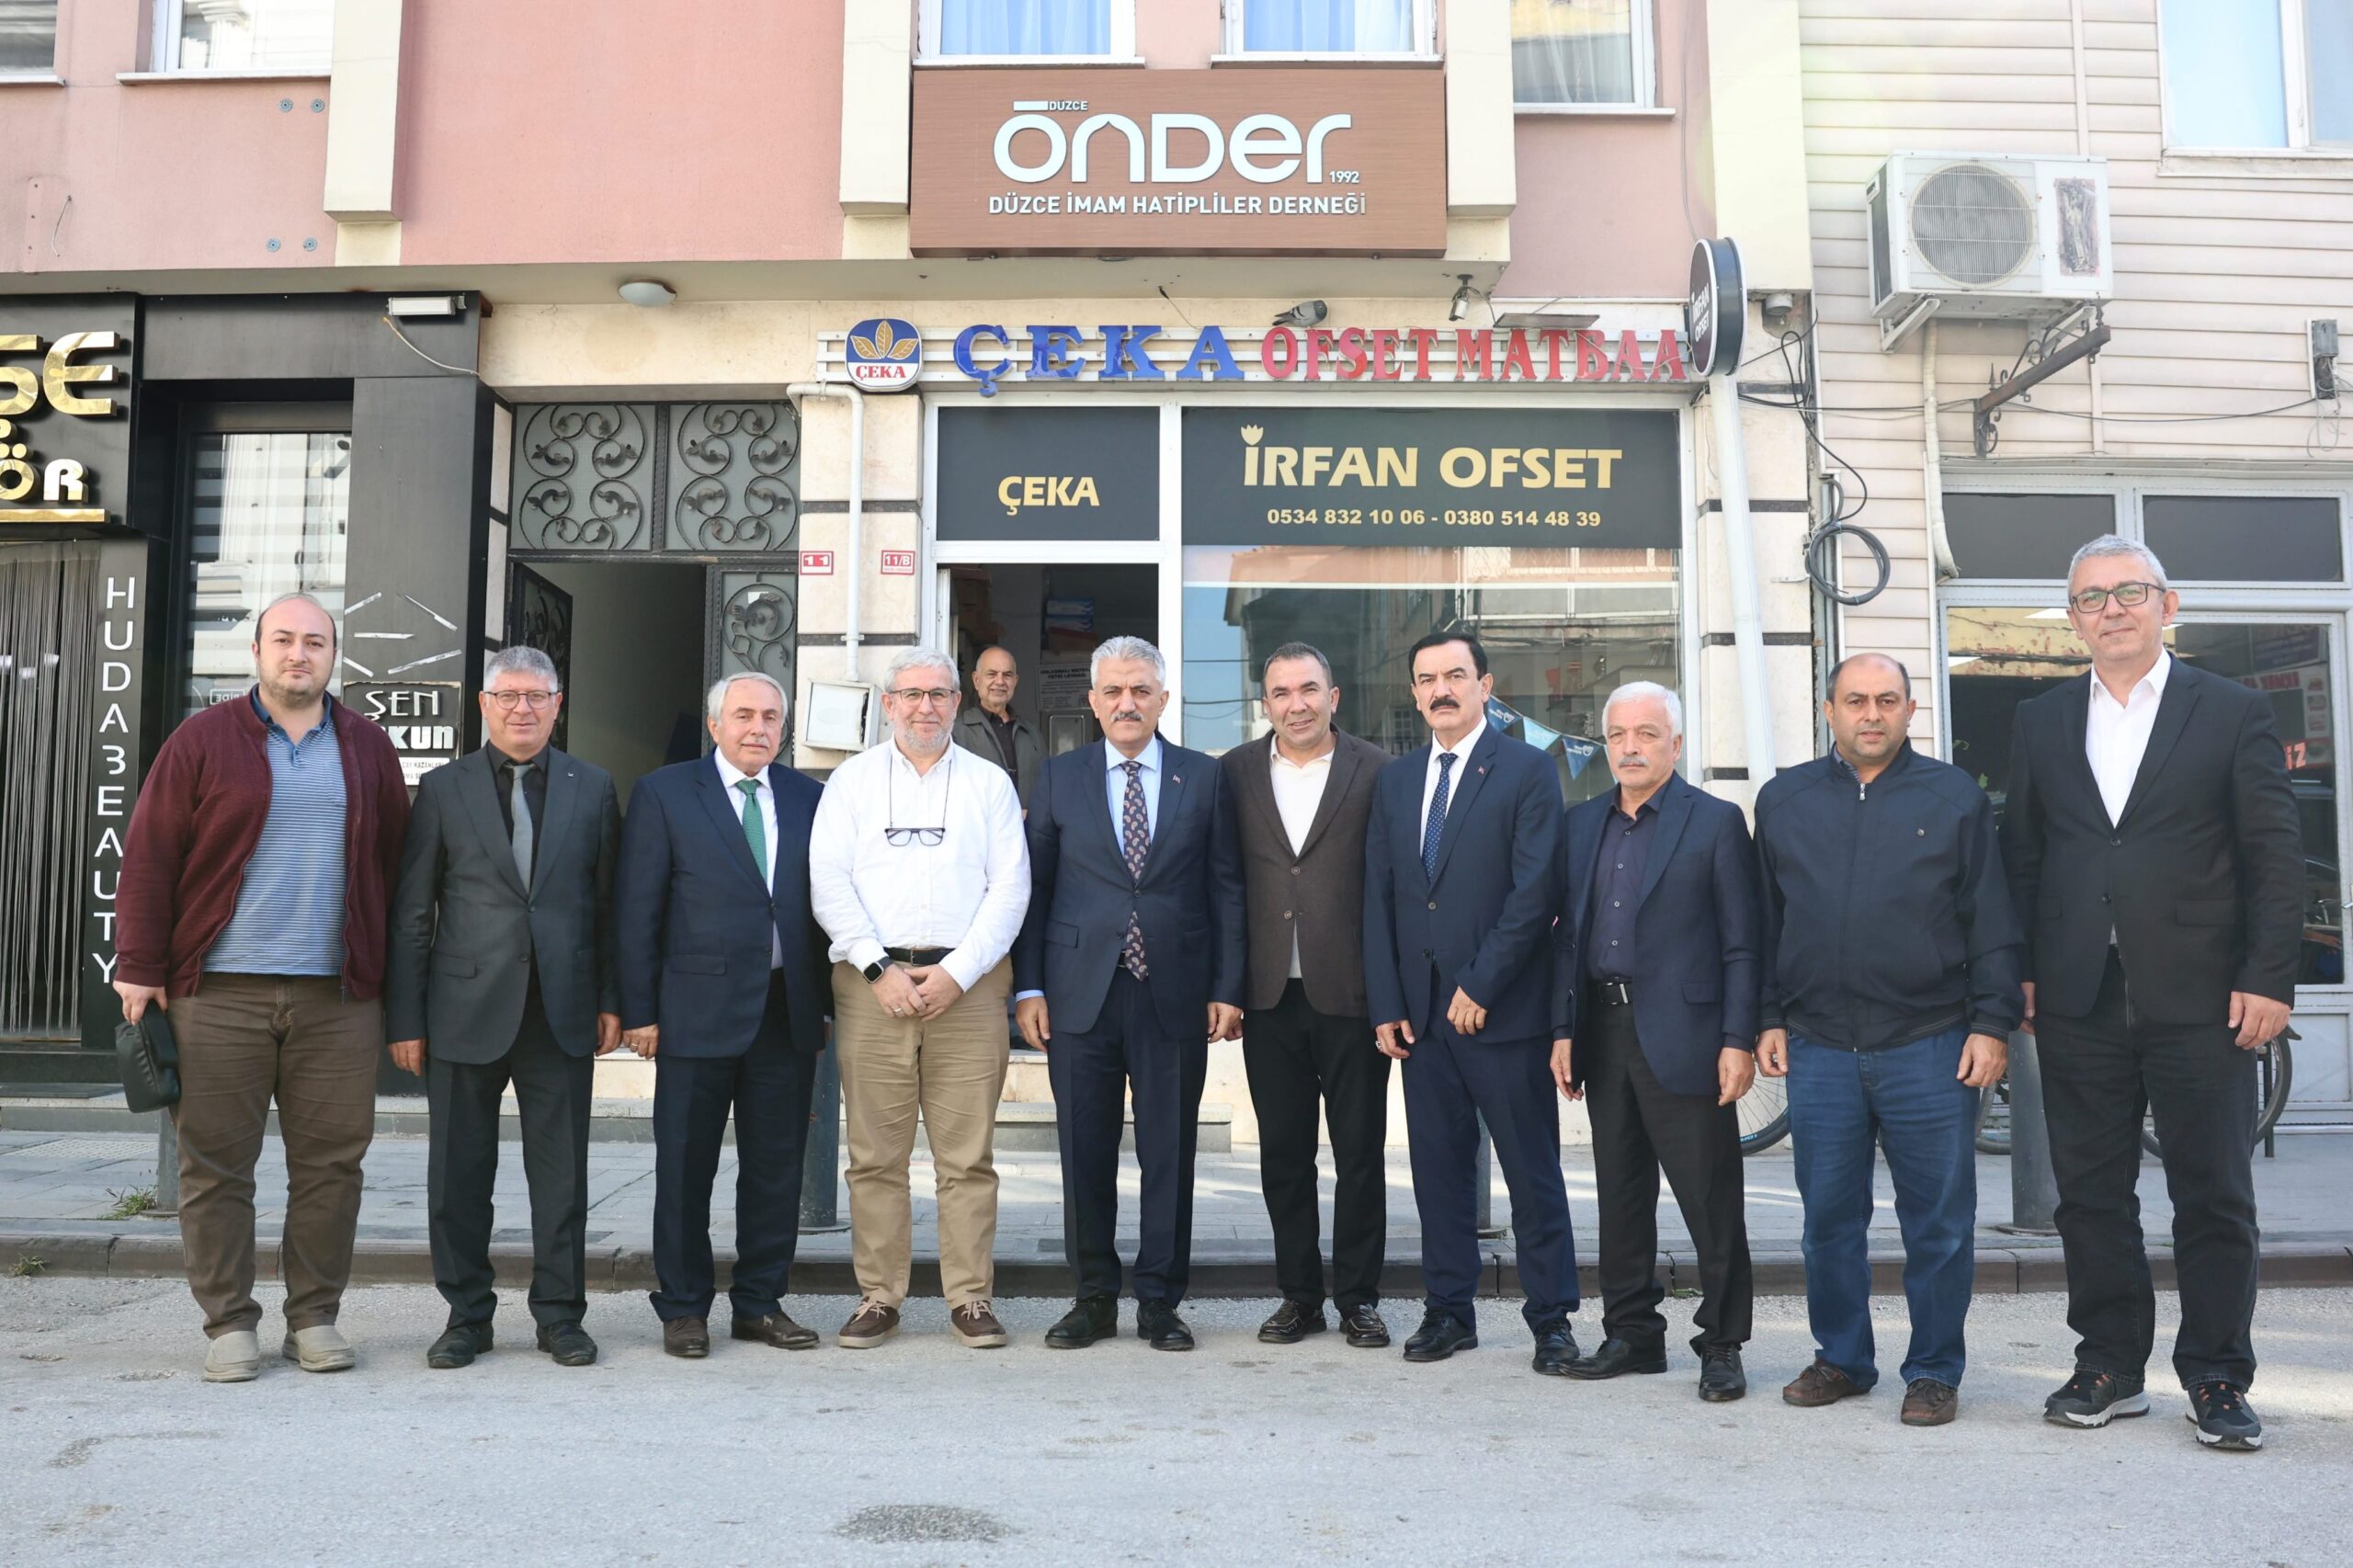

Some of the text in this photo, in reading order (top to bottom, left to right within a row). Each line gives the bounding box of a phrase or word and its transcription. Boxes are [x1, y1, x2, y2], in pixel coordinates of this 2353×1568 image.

[1049, 99, 1088, 111] DÜZCE
[1329, 170, 1360, 183] 1992
[989, 191, 1366, 214] DÜZCE İMAM HATİPLİLER DERNEĞİ
[953, 324, 1688, 397] ÇEKA OFSET MATBAA
[856, 365, 906, 381] ÇEKA
[1241, 425, 1622, 489] İRFAN OFSET
[997, 475, 1100, 516] ÇEKA
[1267, 509, 1318, 525] 0534
[1324, 509, 1362, 525] 832
[1369, 509, 1394, 525] 10
[1400, 509, 1426, 525] 06
[1444, 510, 1495, 526] 0380
[1501, 510, 1539, 526] 514
[1544, 511, 1570, 527] 48
[1576, 511, 1601, 527] 39
[885, 554, 912, 567] 11/B
